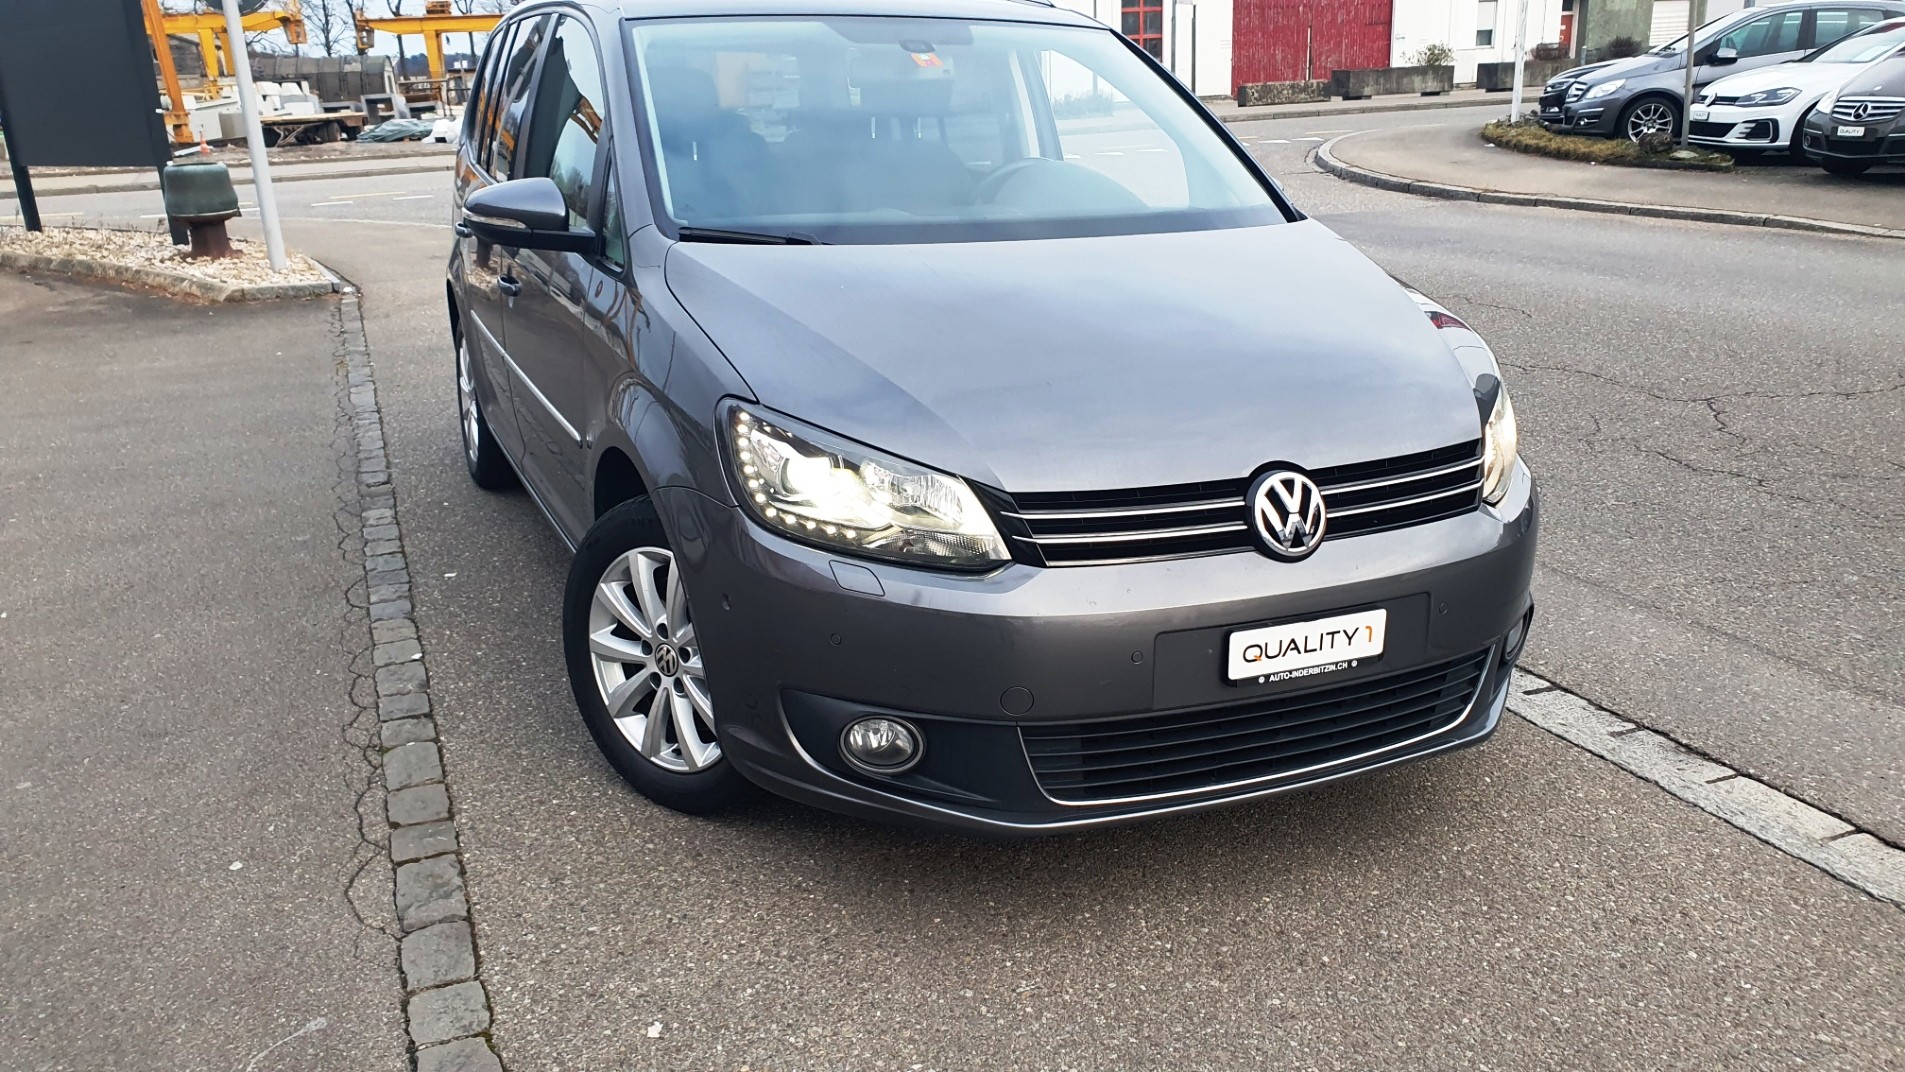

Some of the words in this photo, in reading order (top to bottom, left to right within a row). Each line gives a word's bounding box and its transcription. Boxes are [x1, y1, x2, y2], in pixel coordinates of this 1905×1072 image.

[1254, 471, 1326, 553] VW
[1242, 627, 1360, 663] QUALITY
[1364, 625, 1373, 643] 1
[1269, 661, 1348, 682] AUTO-INDERBITZIN.CH
